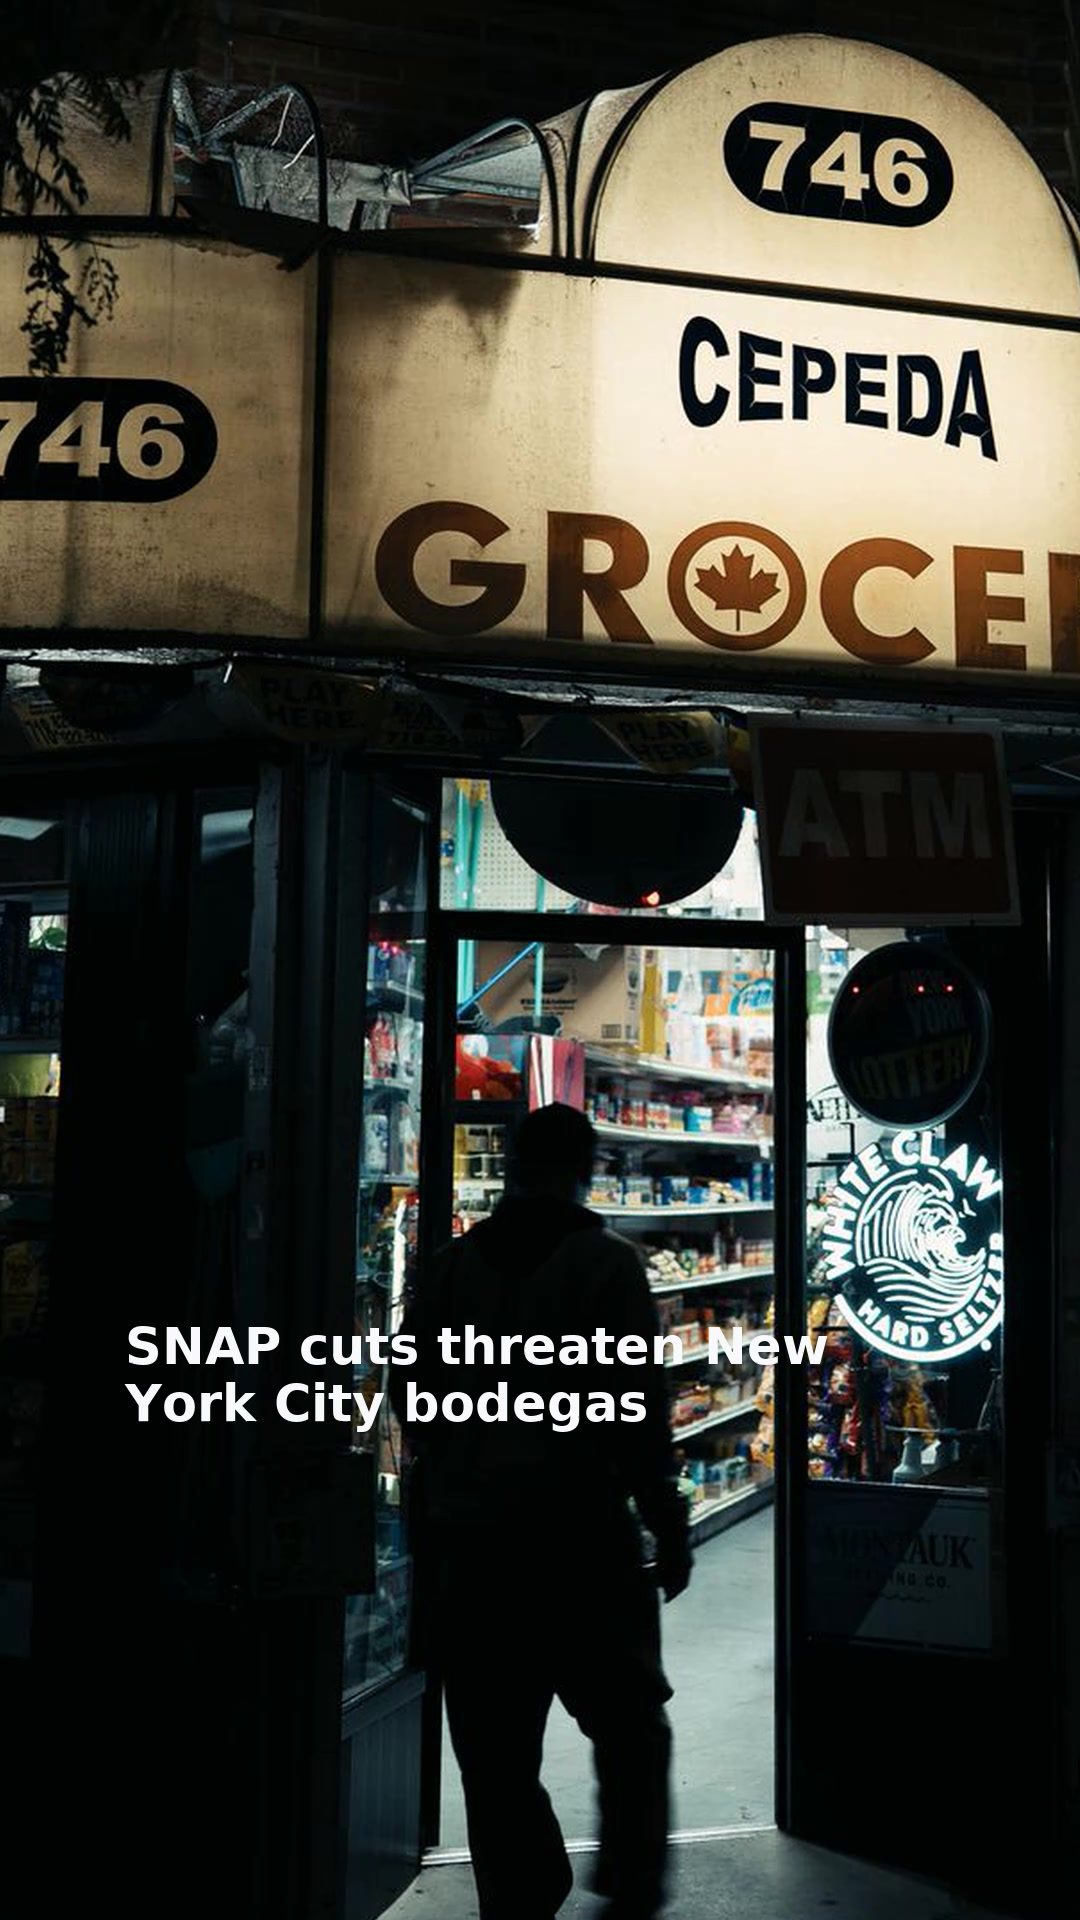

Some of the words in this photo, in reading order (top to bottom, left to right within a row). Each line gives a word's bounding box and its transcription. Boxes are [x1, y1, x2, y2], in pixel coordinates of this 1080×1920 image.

[748, 120, 930, 209] 746
[679, 316, 999, 462] CEPEDA
[260, 675, 348, 701] PLAY
[618, 720, 690, 740] PLAY
[777, 767, 993, 861] ATM
[903, 998, 968, 1040] YORK
[850, 1030, 974, 1101] LOTTERY
[822, 1143, 891, 1281] WHITE
[891, 1130, 1004, 1202] CLAW
[857, 1298, 929, 1348] HARD
